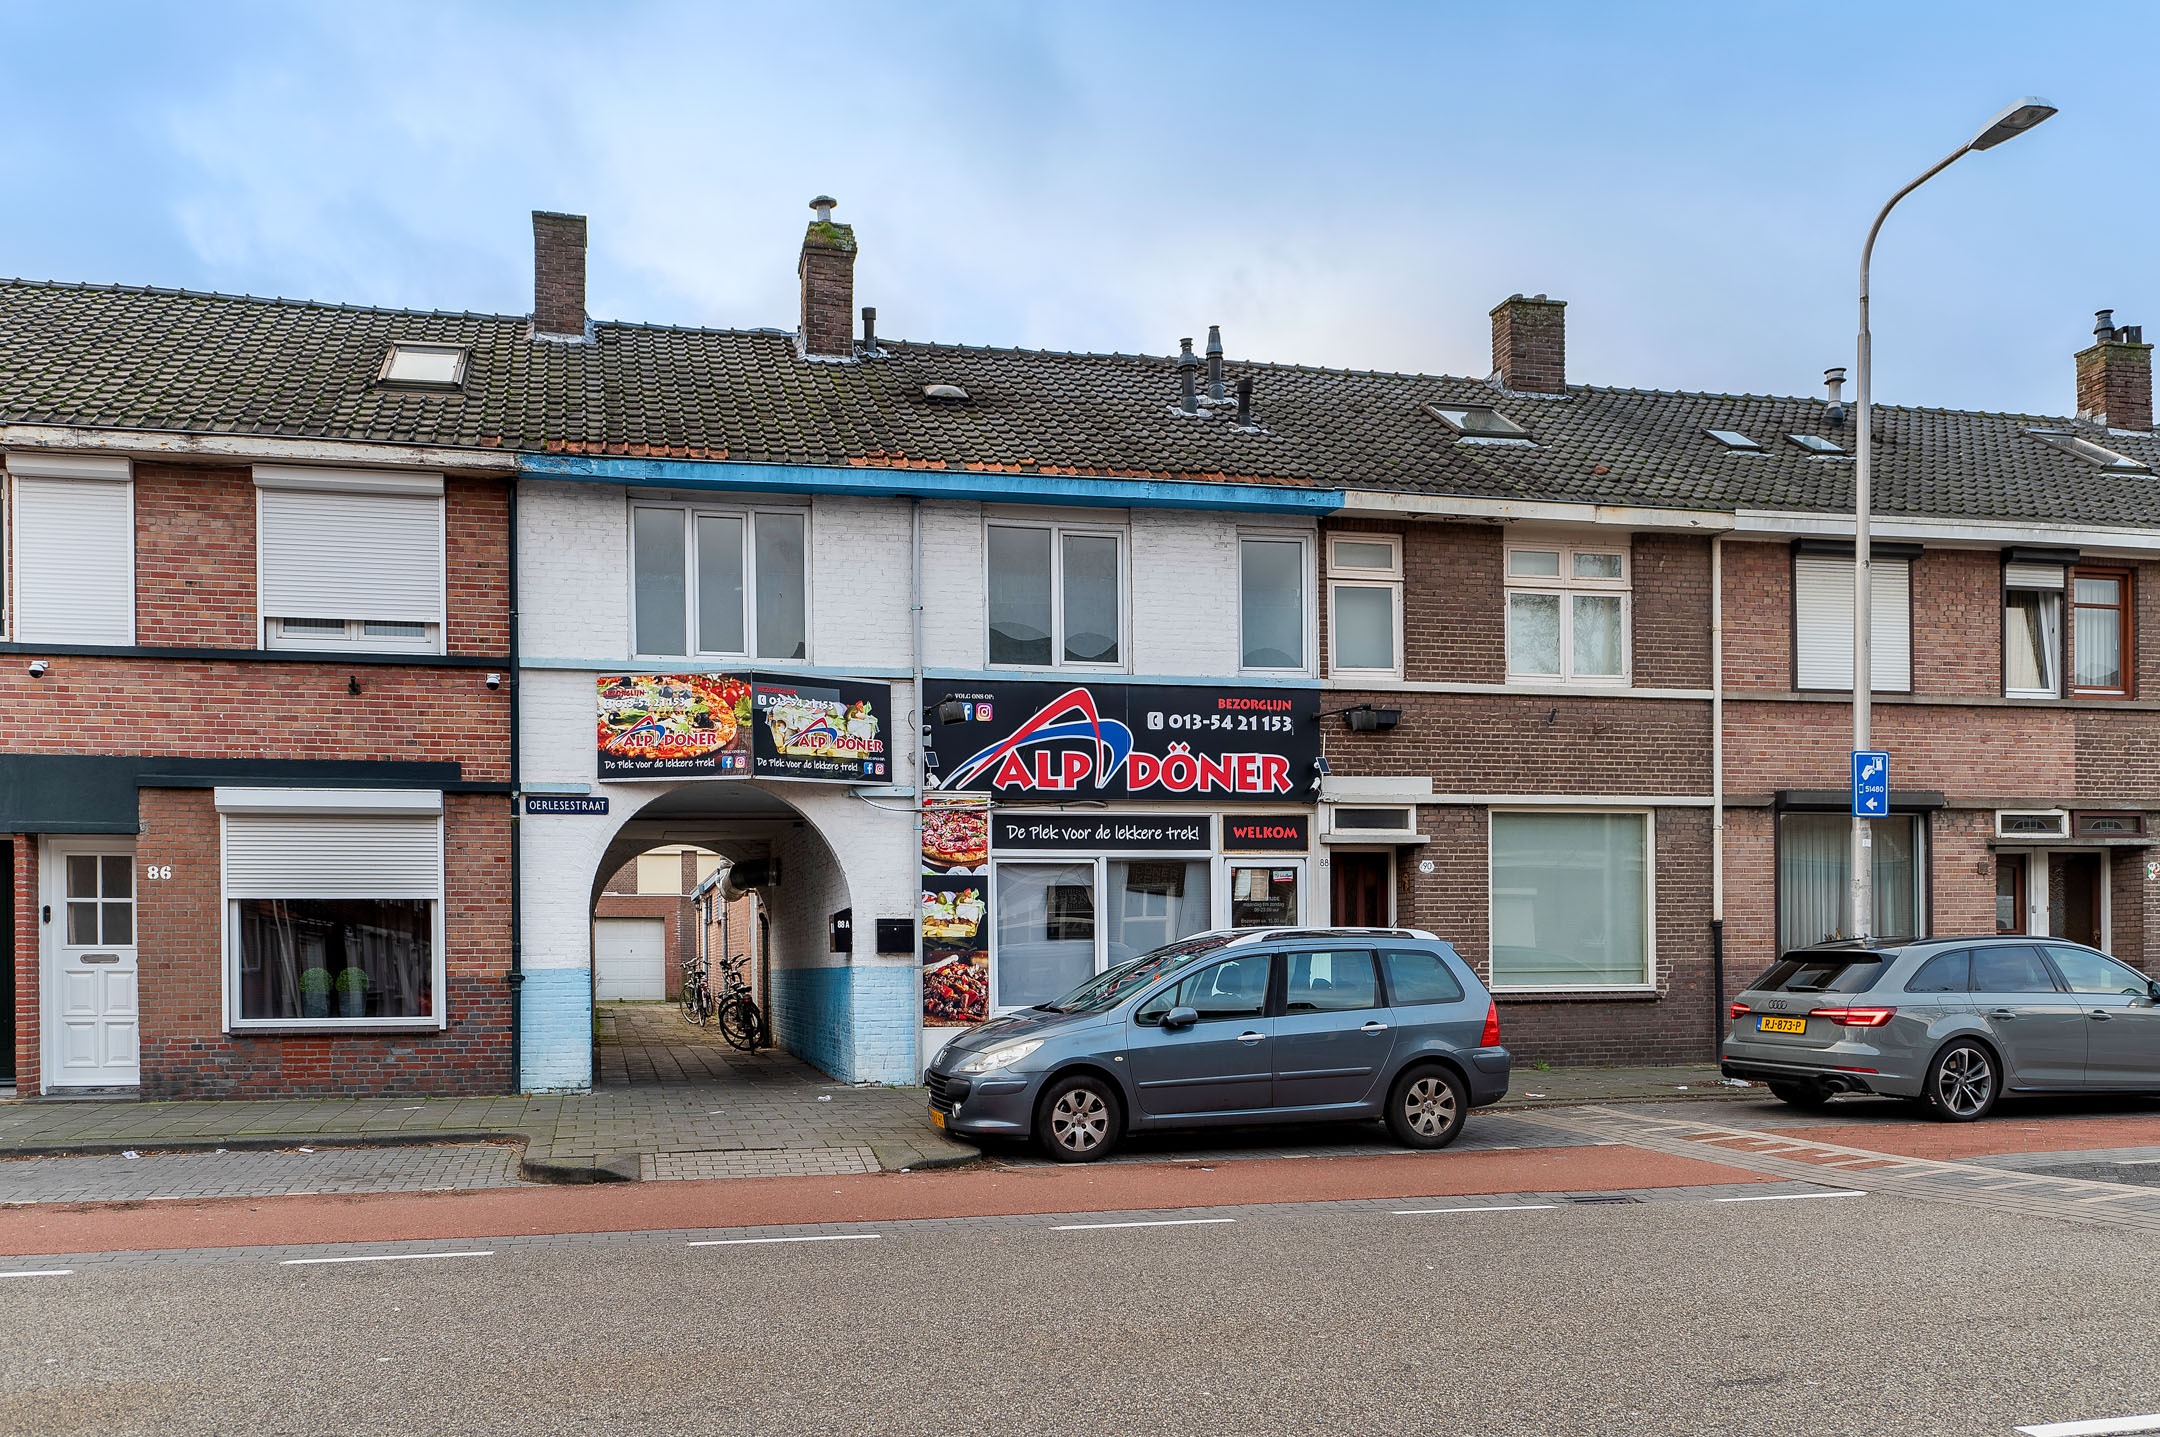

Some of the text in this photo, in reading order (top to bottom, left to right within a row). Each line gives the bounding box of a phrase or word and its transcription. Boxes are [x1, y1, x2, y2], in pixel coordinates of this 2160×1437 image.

[1217, 698, 1292, 712] BEZORGLIJN
[1168, 713, 1292, 732] 013-54 21 153
[623, 730, 717, 748] ALP DÖNER
[799, 734, 884, 753] ALP DÖNER
[604, 760, 617, 769] De
[618, 760, 634, 769] Plek
[635, 759, 652, 768] voor
[654, 758, 663, 768] de
[665, 757, 693, 767] lekkere
[757, 757, 768, 767] De
[769, 758, 785, 768] Plek
[785, 760, 802, 769] voor
[803, 760, 812, 769] de
[813, 760, 839, 771] lekkere
[992, 741, 1294, 795] ALP DÖNER
[529, 800, 606, 811] OERLESESTRAAT
[1006, 824, 1200, 841] De Plek voor de lekkere trek!
[1232, 826, 1298, 839] WELKOM
[1320, 859, 1330, 867] 88
[1423, 861, 1433, 870] 90
[147, 865, 172, 880] 86
[845, 920, 850, 928] A
[1764, 1018, 1801, 1031] RJ-873-P
